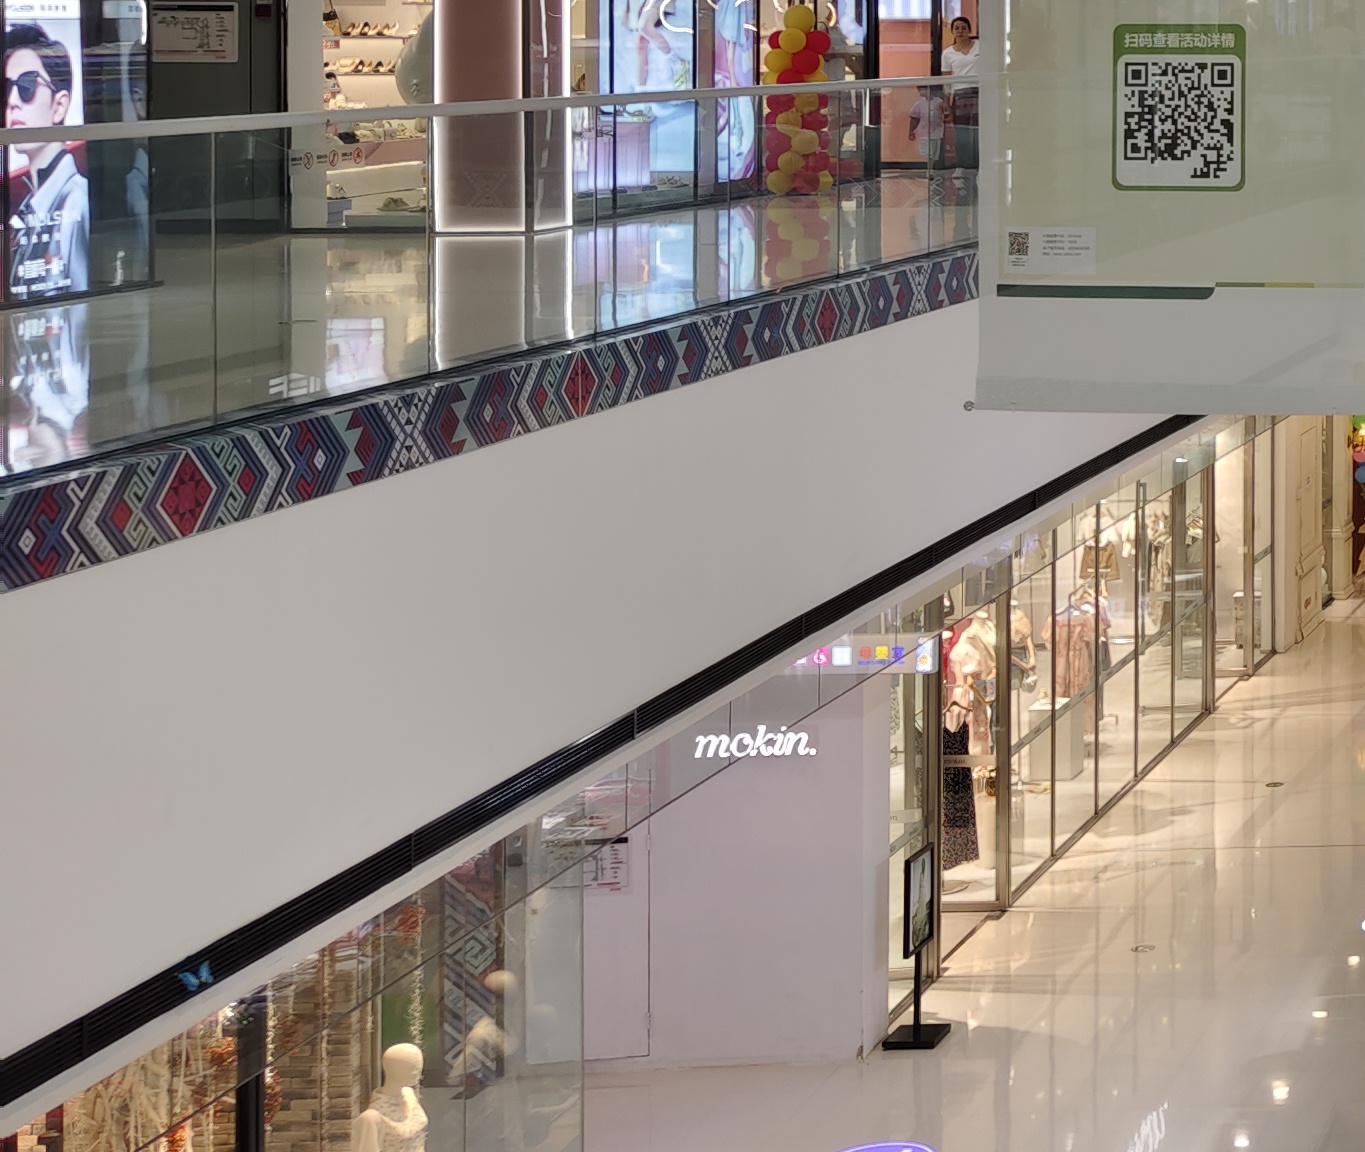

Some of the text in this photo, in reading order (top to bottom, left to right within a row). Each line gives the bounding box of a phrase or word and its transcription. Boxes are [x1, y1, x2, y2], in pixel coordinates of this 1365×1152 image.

[1124, 32, 1236, 48] 扫码查看活动详情
[693, 724, 817, 759] mokin.
